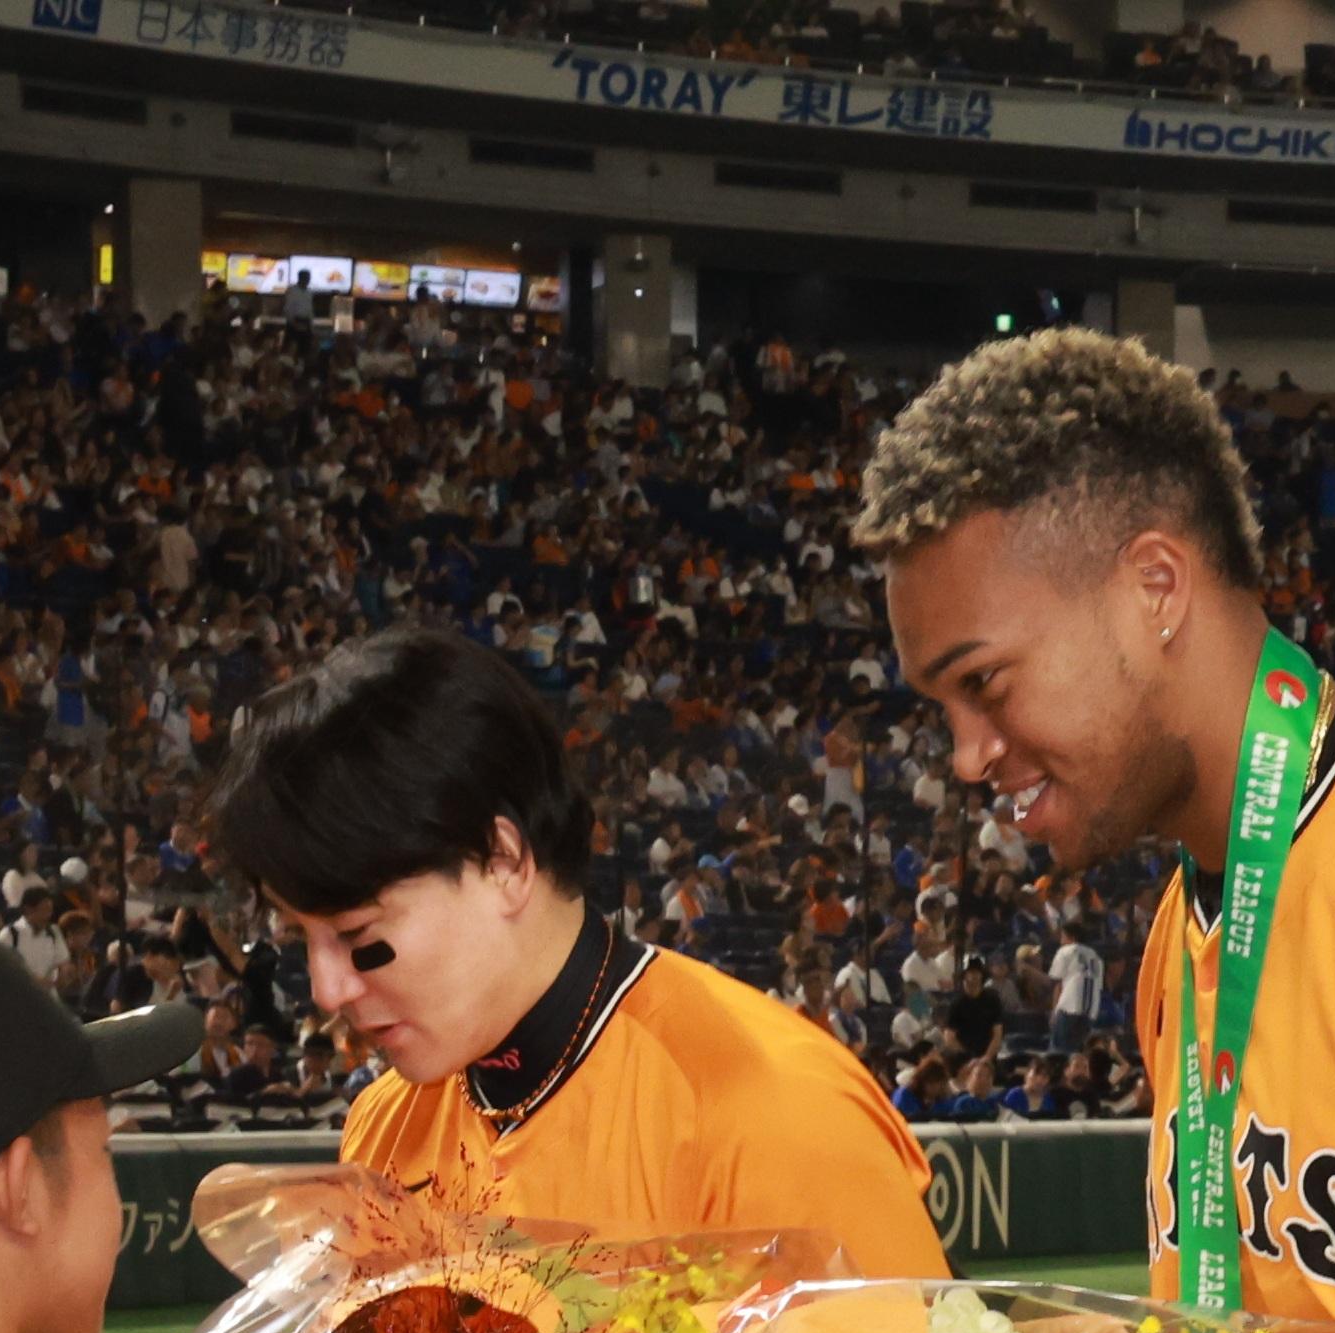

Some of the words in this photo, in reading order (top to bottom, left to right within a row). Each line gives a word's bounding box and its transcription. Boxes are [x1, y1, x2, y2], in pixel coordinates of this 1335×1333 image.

[778, 72, 992, 140] 東レ建設
[1239, 731, 1290, 842] CENTRAL
[1226, 862, 1264, 959] LEAGUE
[1197, 1249, 1226, 1310] LEAG
